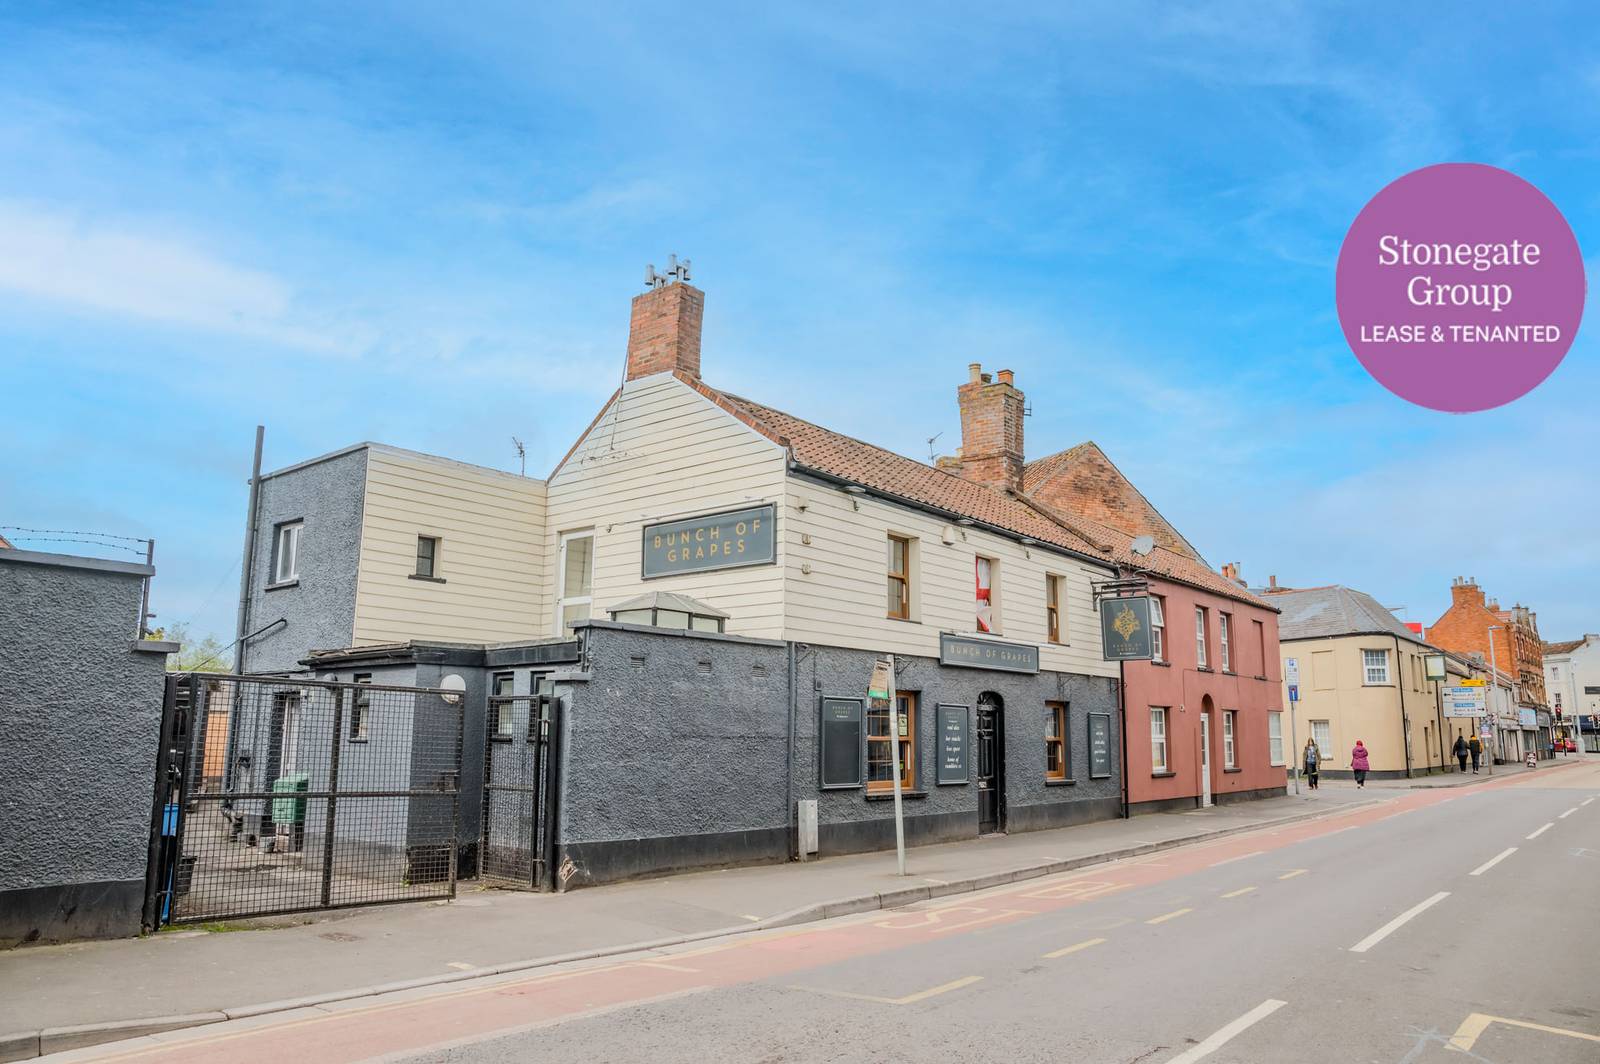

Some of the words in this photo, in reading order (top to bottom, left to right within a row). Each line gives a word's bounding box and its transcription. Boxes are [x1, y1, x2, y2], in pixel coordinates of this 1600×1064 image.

[654, 526, 720, 549] BUNCH
[735, 519, 761, 536] OF
[667, 539, 745, 562] GRAPES
